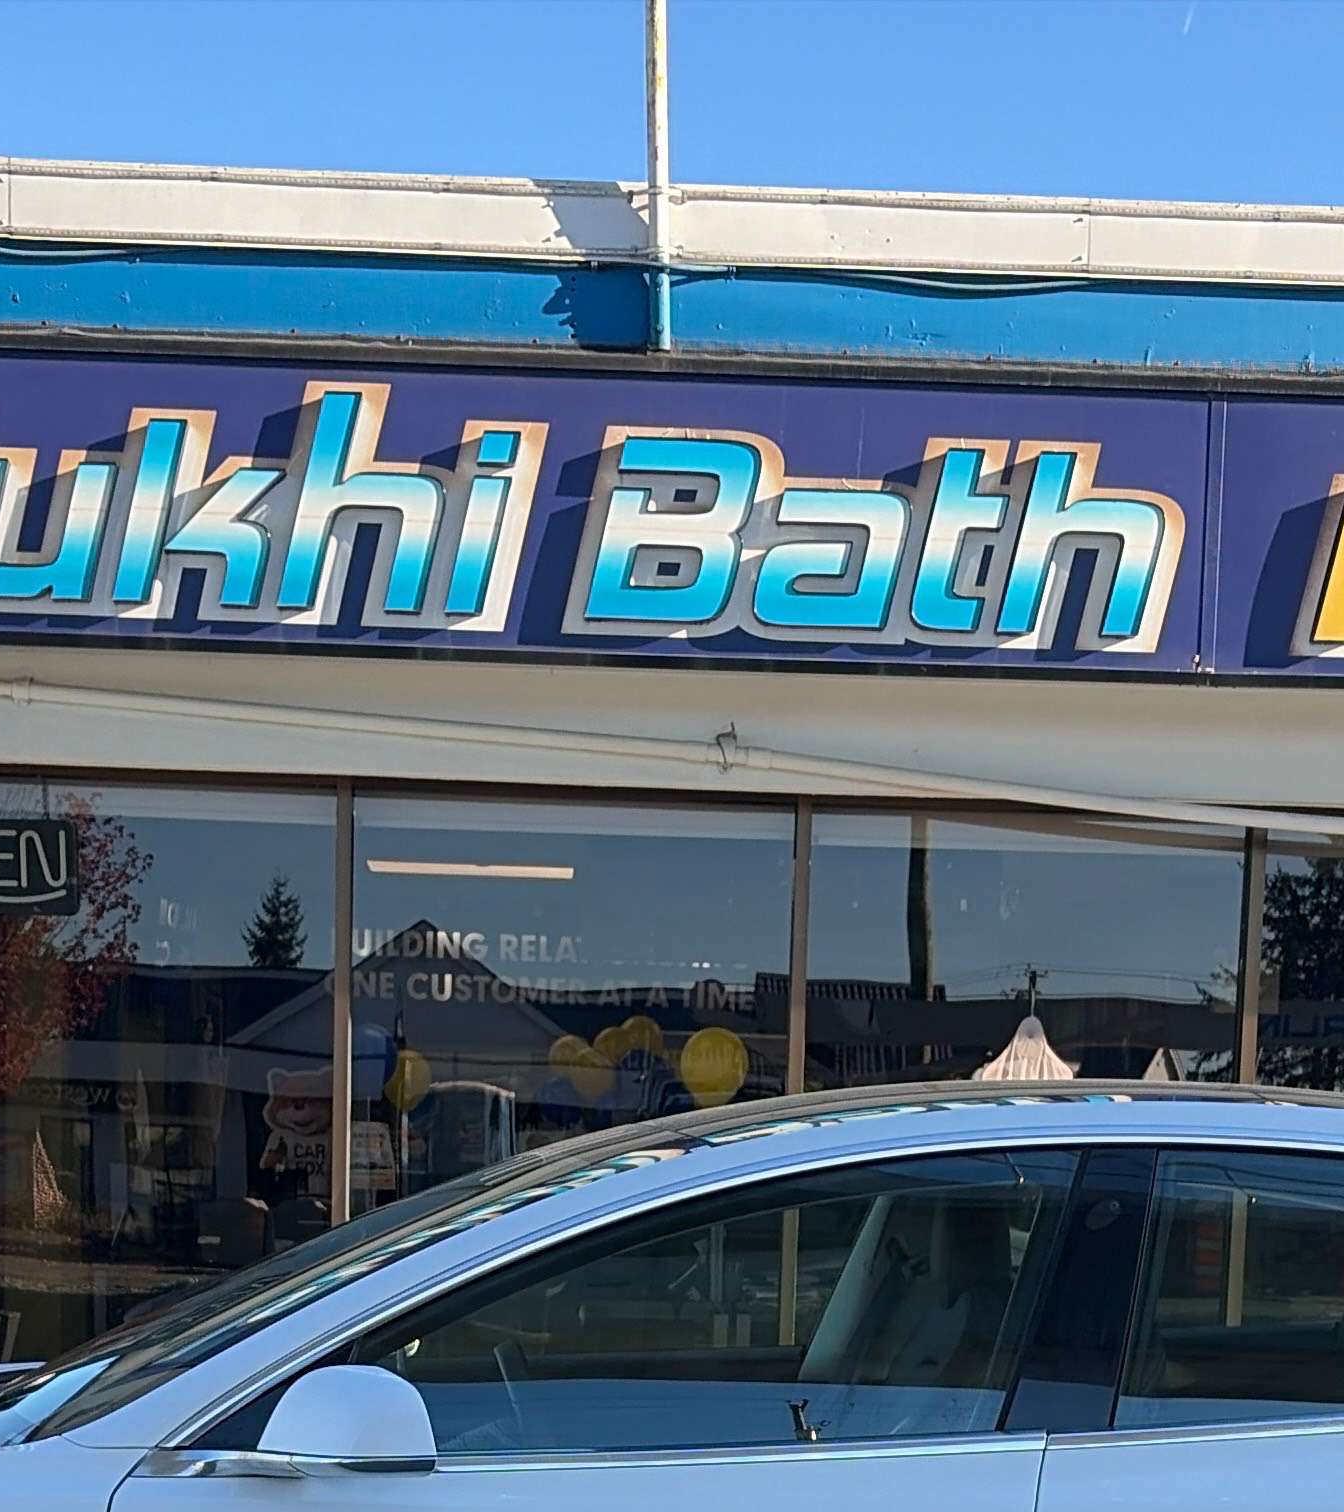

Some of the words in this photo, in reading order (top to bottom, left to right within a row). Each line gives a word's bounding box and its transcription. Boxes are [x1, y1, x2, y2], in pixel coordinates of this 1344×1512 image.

[561, 425, 1187, 653] Bath
[332, 927, 488, 961] UILDING
[499, 933, 582, 964] RELA
[406, 973, 590, 1005] CUSTOMER
[676, 981, 756, 1012] TIME
[294, 1142, 326, 1159] CAR
